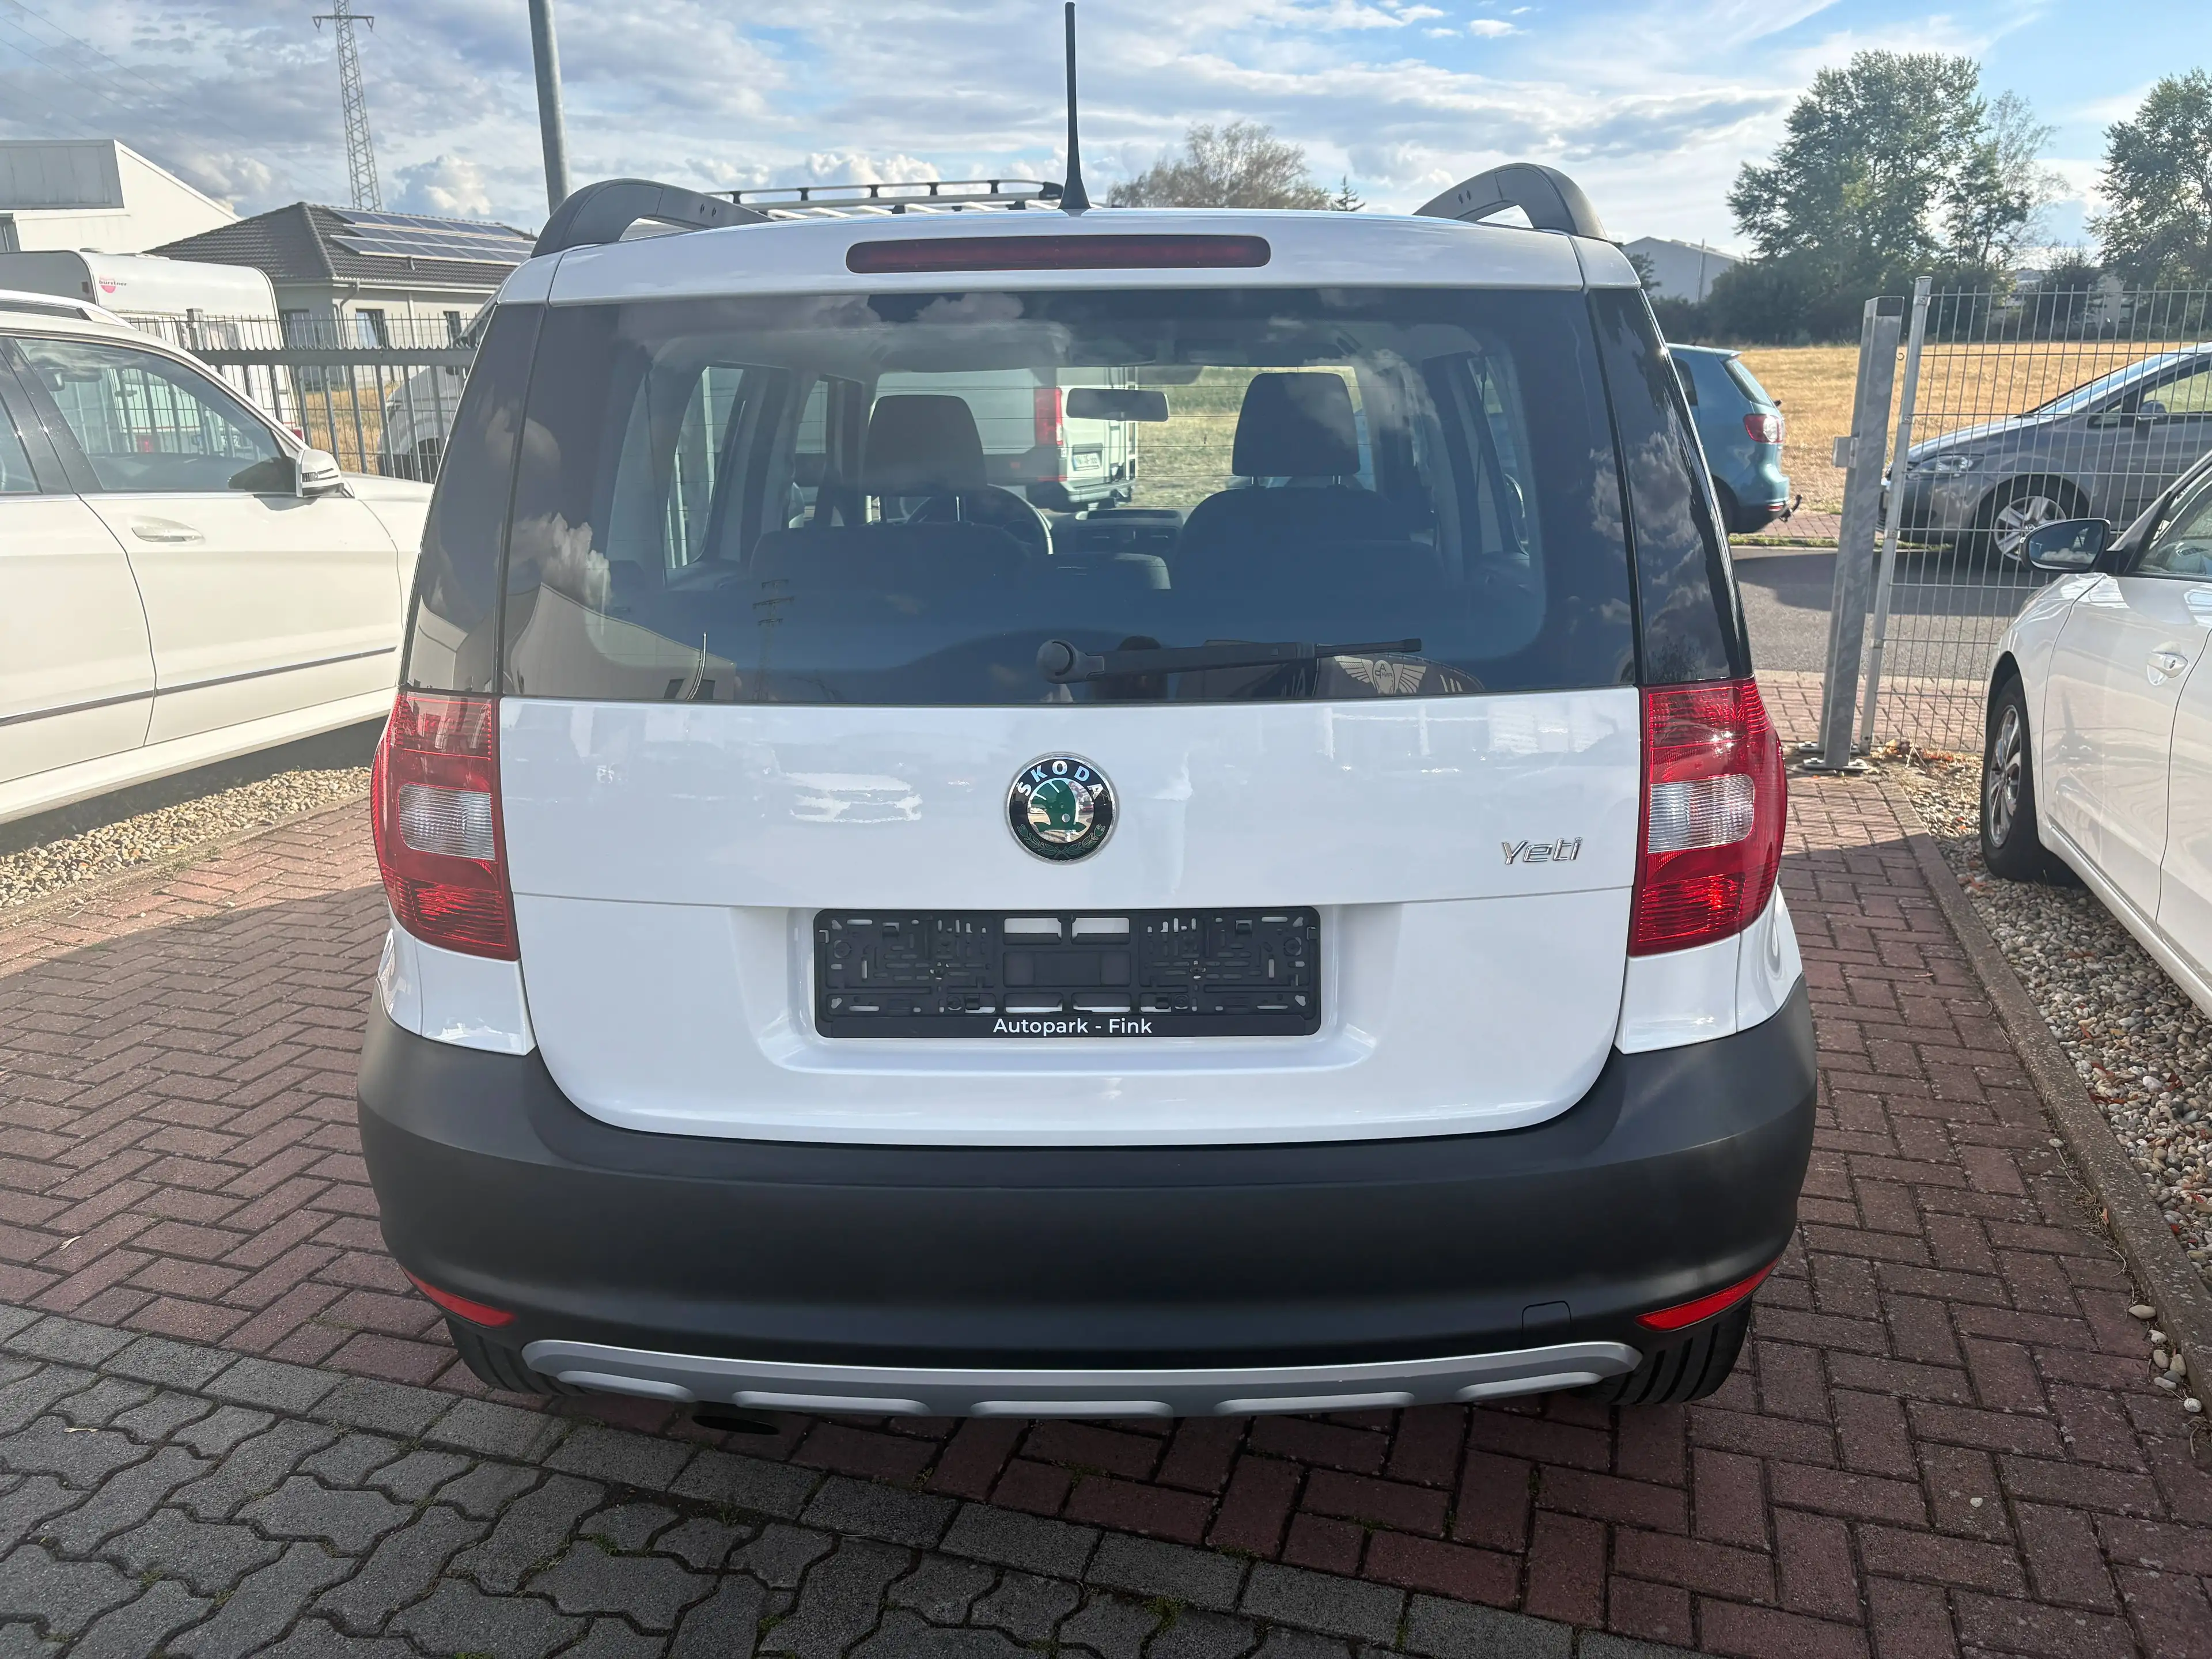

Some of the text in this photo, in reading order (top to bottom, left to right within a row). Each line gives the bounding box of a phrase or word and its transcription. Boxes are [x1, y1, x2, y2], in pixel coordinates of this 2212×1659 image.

[1501, 836, 1583, 865] Yeti
[993, 1018, 1088, 1036] Autopark
[1109, 1018, 1152, 1033] Fink
